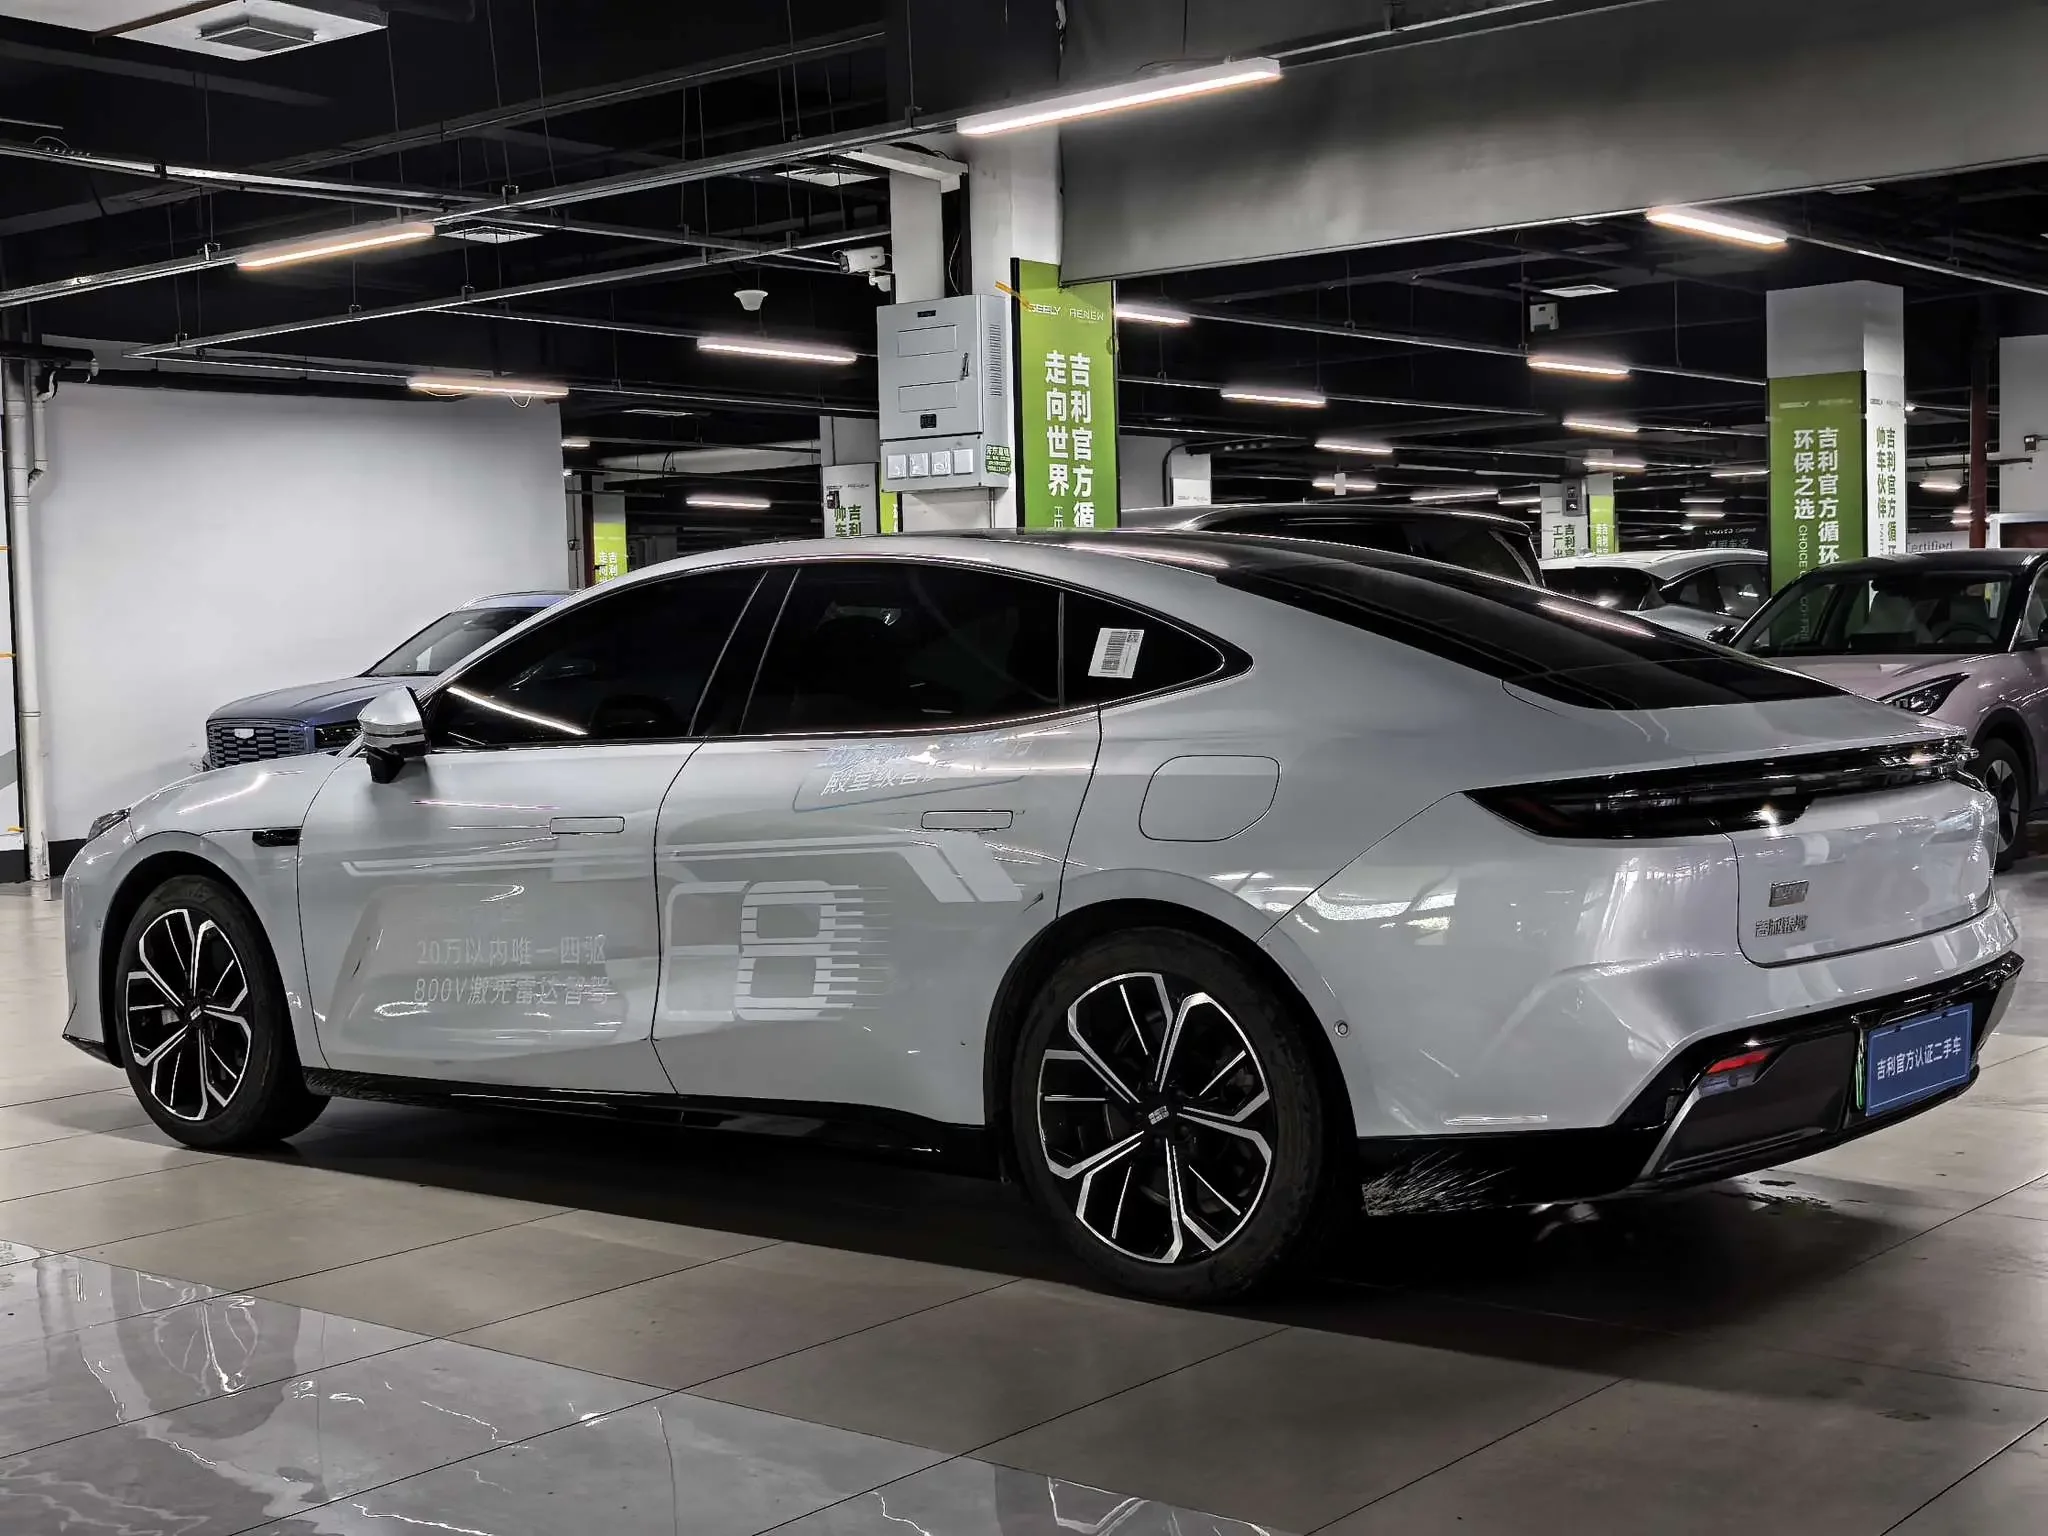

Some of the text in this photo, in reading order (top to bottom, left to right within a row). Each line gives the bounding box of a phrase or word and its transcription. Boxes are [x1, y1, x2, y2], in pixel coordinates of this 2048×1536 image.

[1069, 308, 1104, 321] RENEW
[1044, 350, 1069, 497] 走向世界
[1069, 352, 1095, 528] 吉利官方循
[1793, 429, 1815, 520] 环保之选
[1817, 427, 1840, 566] 吉利官方循环
[1798, 525, 1808, 568] CHOICE
[416, 934, 607, 966] 20万以内唯一四驱
[1877, 1035, 1962, 1081] 吉利官方认证二手车
